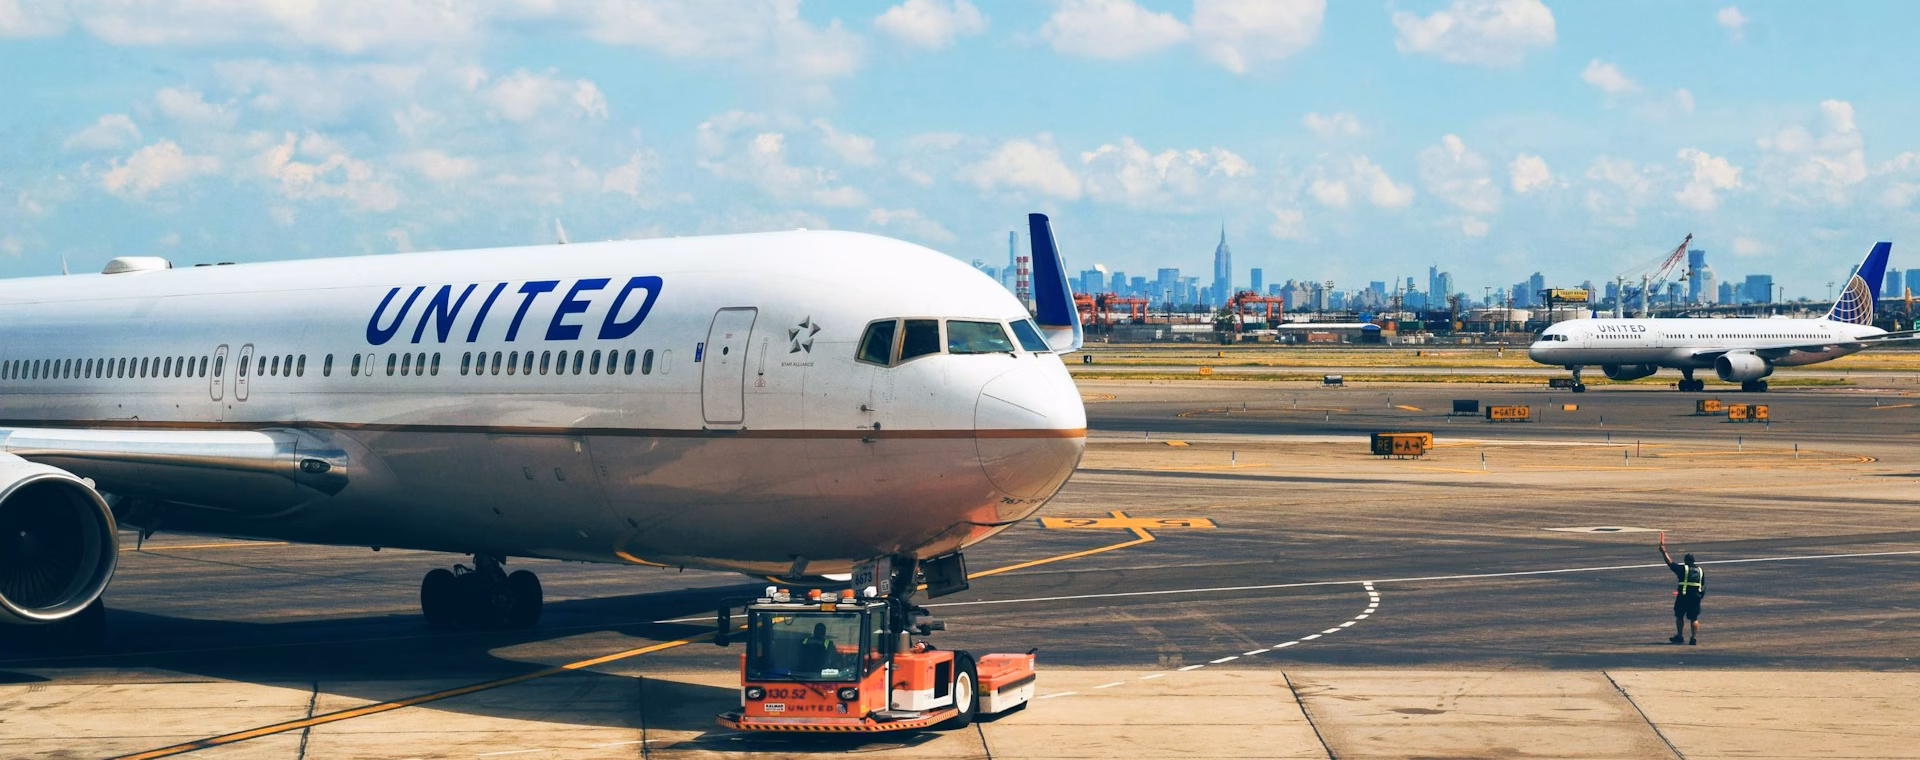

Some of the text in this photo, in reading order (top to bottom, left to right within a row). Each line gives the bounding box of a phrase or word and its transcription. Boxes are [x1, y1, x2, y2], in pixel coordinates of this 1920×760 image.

[366, 276, 663, 345] UNITED
[1598, 325, 1646, 333] UNITED
[1499, 408, 1515, 417] GATE
[1377, 439, 1410, 451] RE A
[1422, 435, 1428, 446] 2
